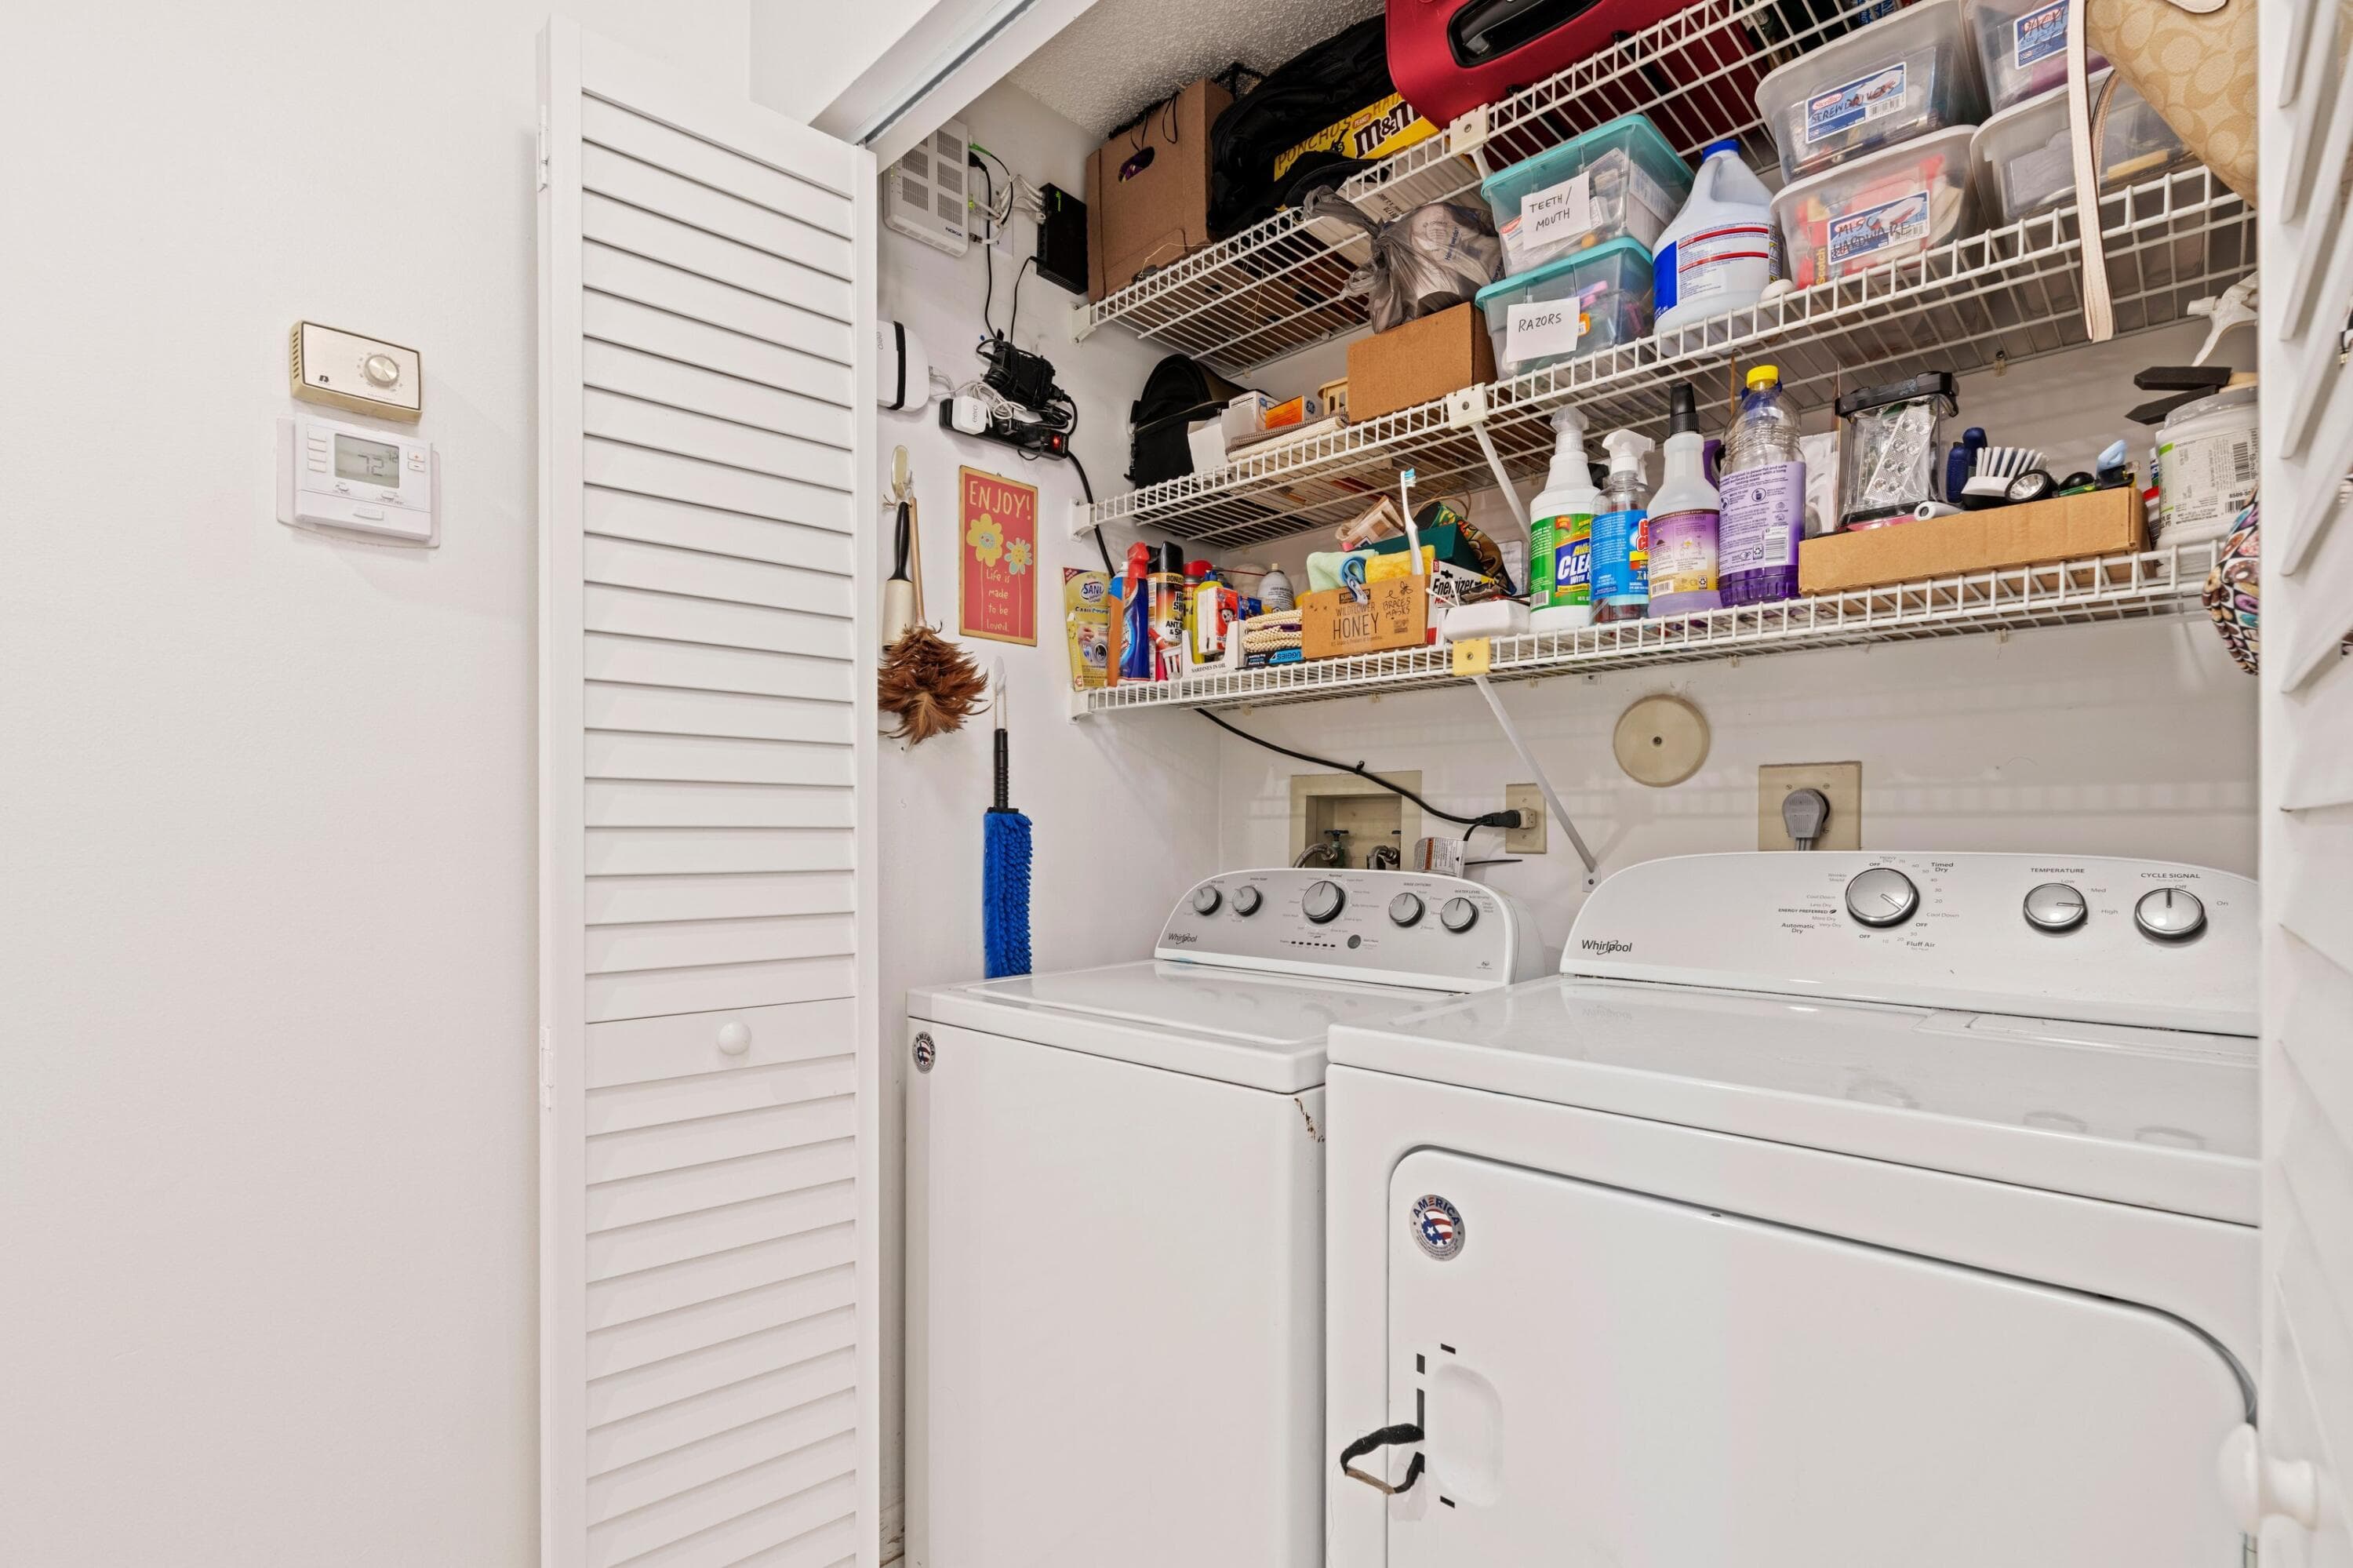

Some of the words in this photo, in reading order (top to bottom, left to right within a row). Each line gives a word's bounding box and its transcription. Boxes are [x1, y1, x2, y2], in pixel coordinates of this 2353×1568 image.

[1535, 208, 1570, 231] MOUTH
[945, 227, 962, 237] NOKIA
[1816, 247, 1827, 286] Scotch
[1518, 313, 1562, 333] RAZORS
[969, 480, 1031, 521] ENJOY!
[988, 589, 1009, 599] made
[1383, 597, 1411, 609] BRACES
[988, 603, 996, 614] to
[999, 604, 1009, 616] be
[1333, 612, 1379, 640] HONEY
[1191, 665, 1213, 674] SARDINES
[1168, 933, 1198, 944] Whirlpool
[1581, 939, 1633, 955] Whirlpool
[915, 1033, 936, 1056] AMERICA
[1413, 1196, 1460, 1226] AMERICA
